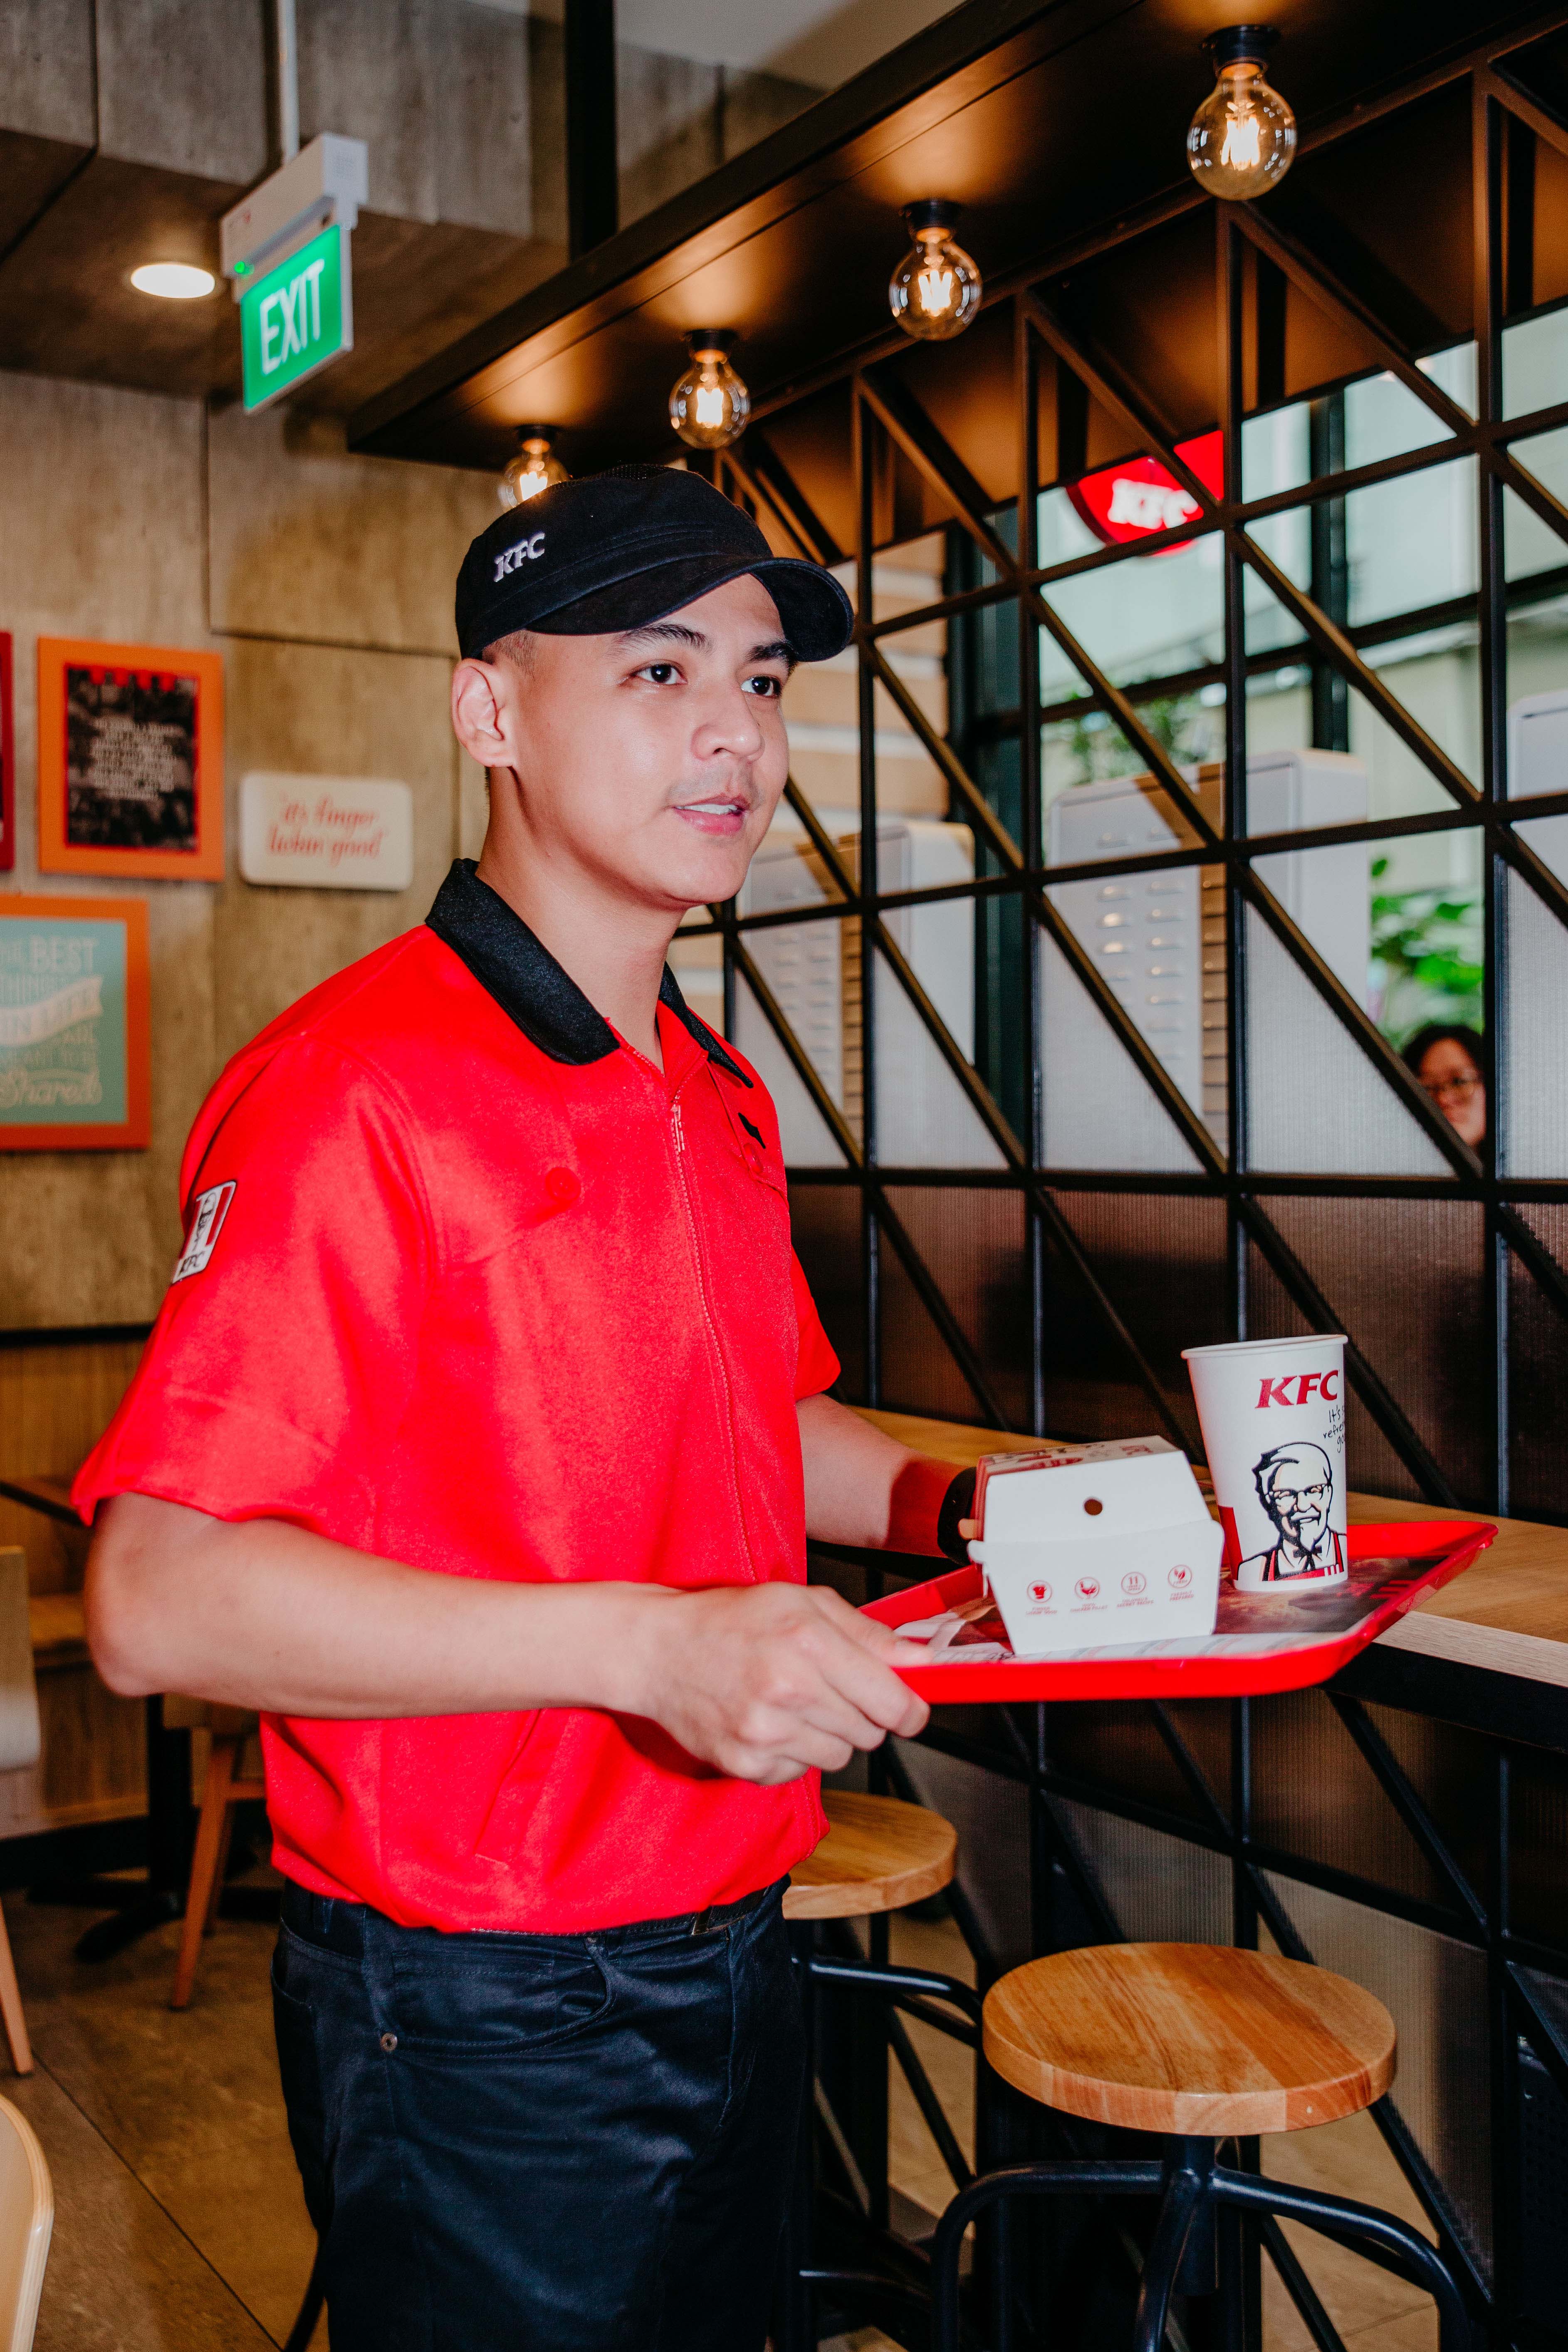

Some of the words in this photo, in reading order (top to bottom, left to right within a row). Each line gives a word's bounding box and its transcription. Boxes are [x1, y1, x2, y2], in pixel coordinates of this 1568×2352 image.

[260, 258, 326, 375] EXIT
[493, 531, 545, 582] KFC
[29, 935, 99, 974] BEST
[1254, 1370, 1339, 1408] KFC
[1329, 1404, 1340, 1422] It's
